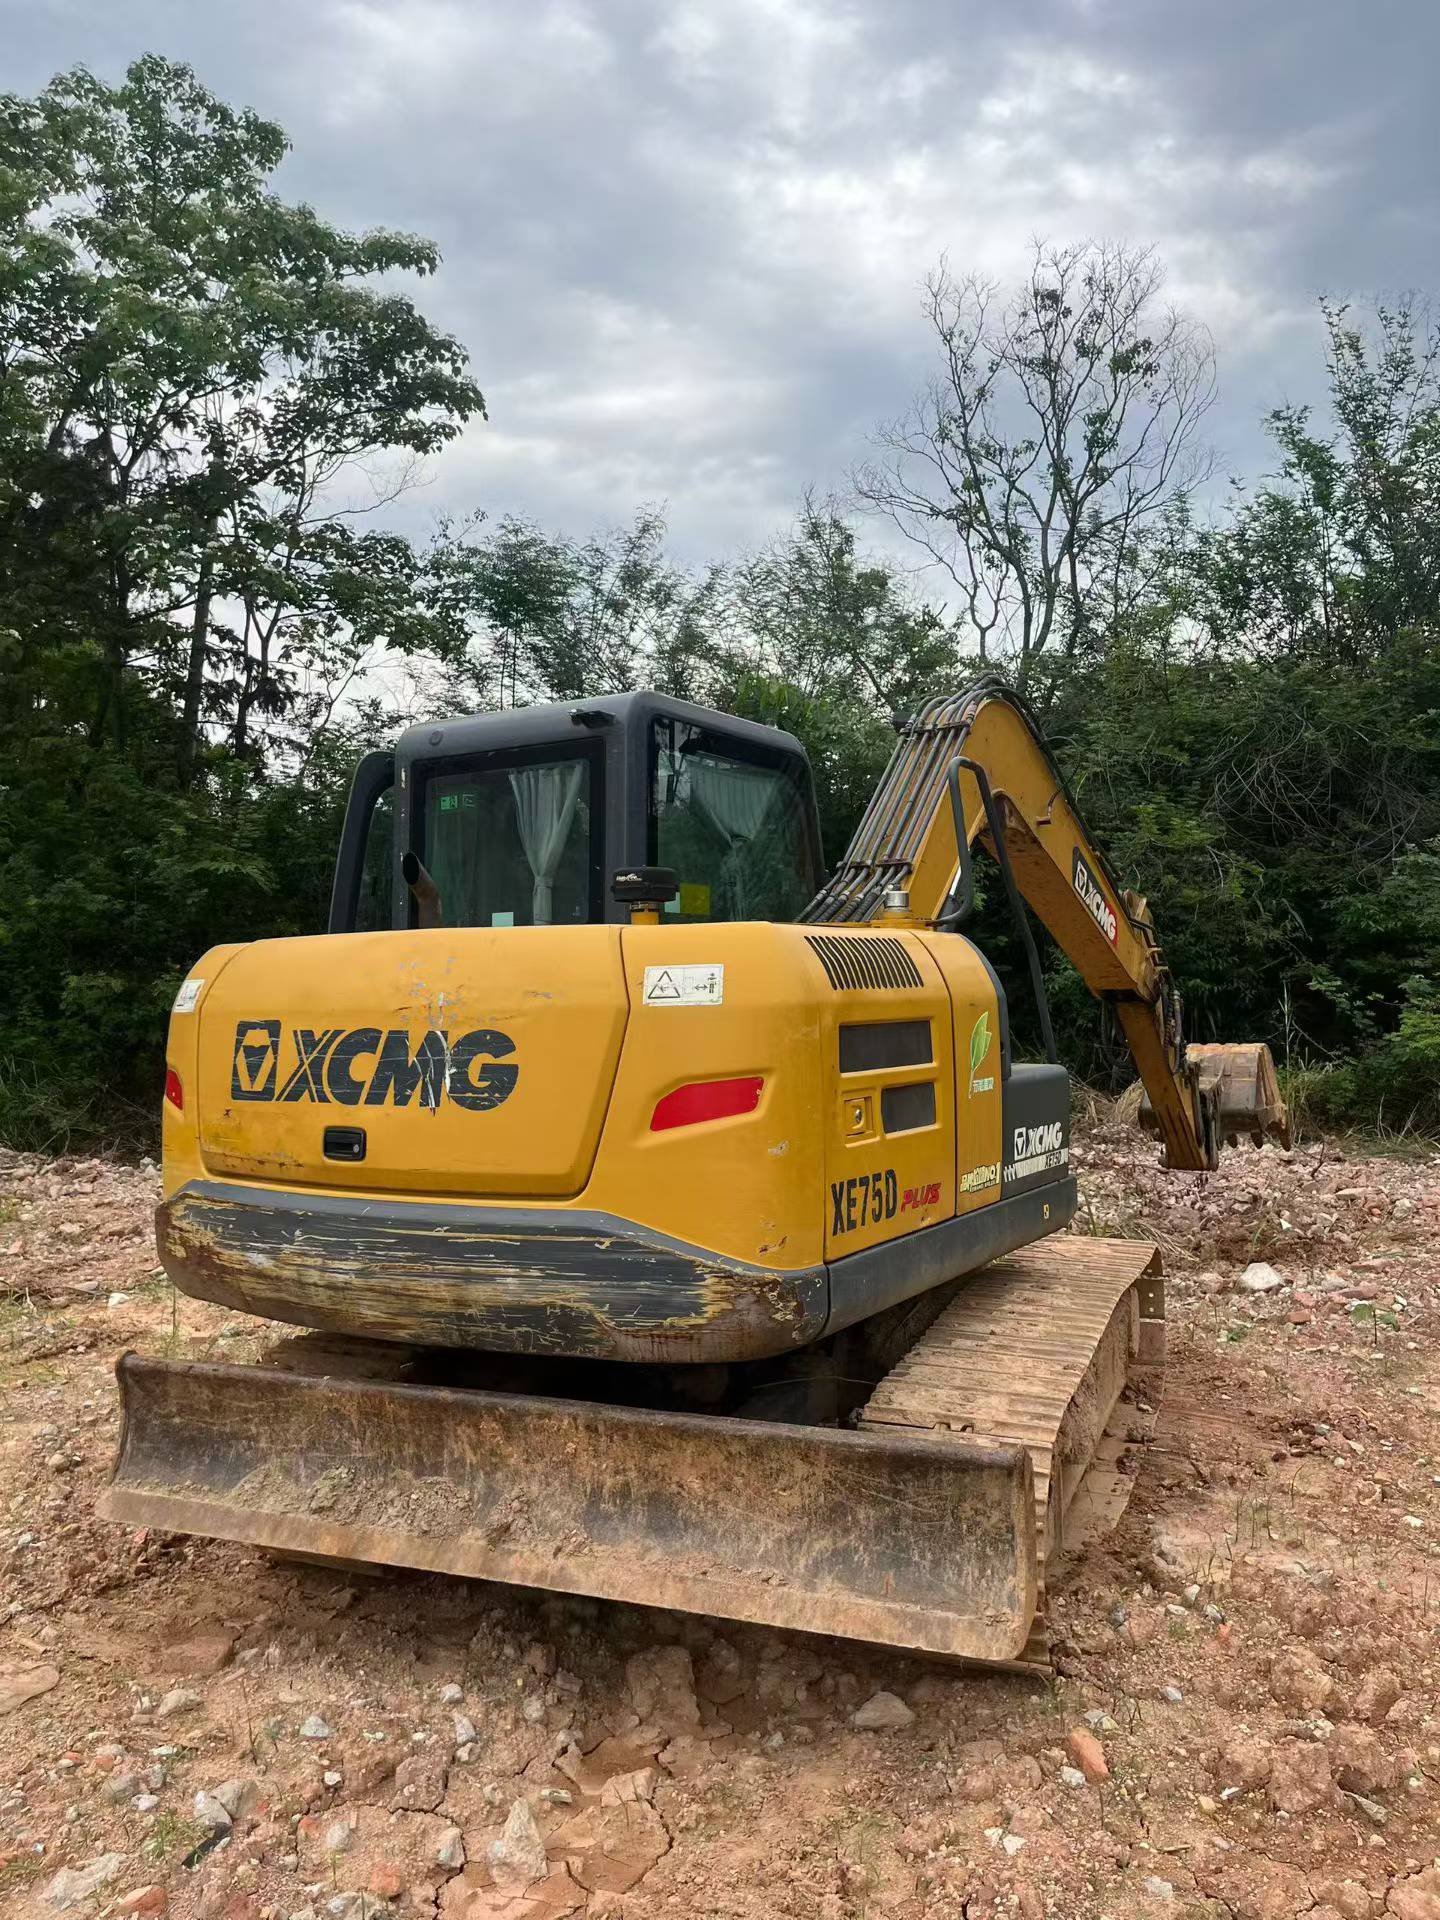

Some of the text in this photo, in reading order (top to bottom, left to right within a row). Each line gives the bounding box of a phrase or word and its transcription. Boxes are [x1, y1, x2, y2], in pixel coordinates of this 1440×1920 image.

[1084, 880, 1116, 941] XCMG
[274, 1028, 519, 1111] XCMG
[1026, 1121, 1062, 1157] XCMG
[831, 1169, 942, 1236] XE75D PLUS
